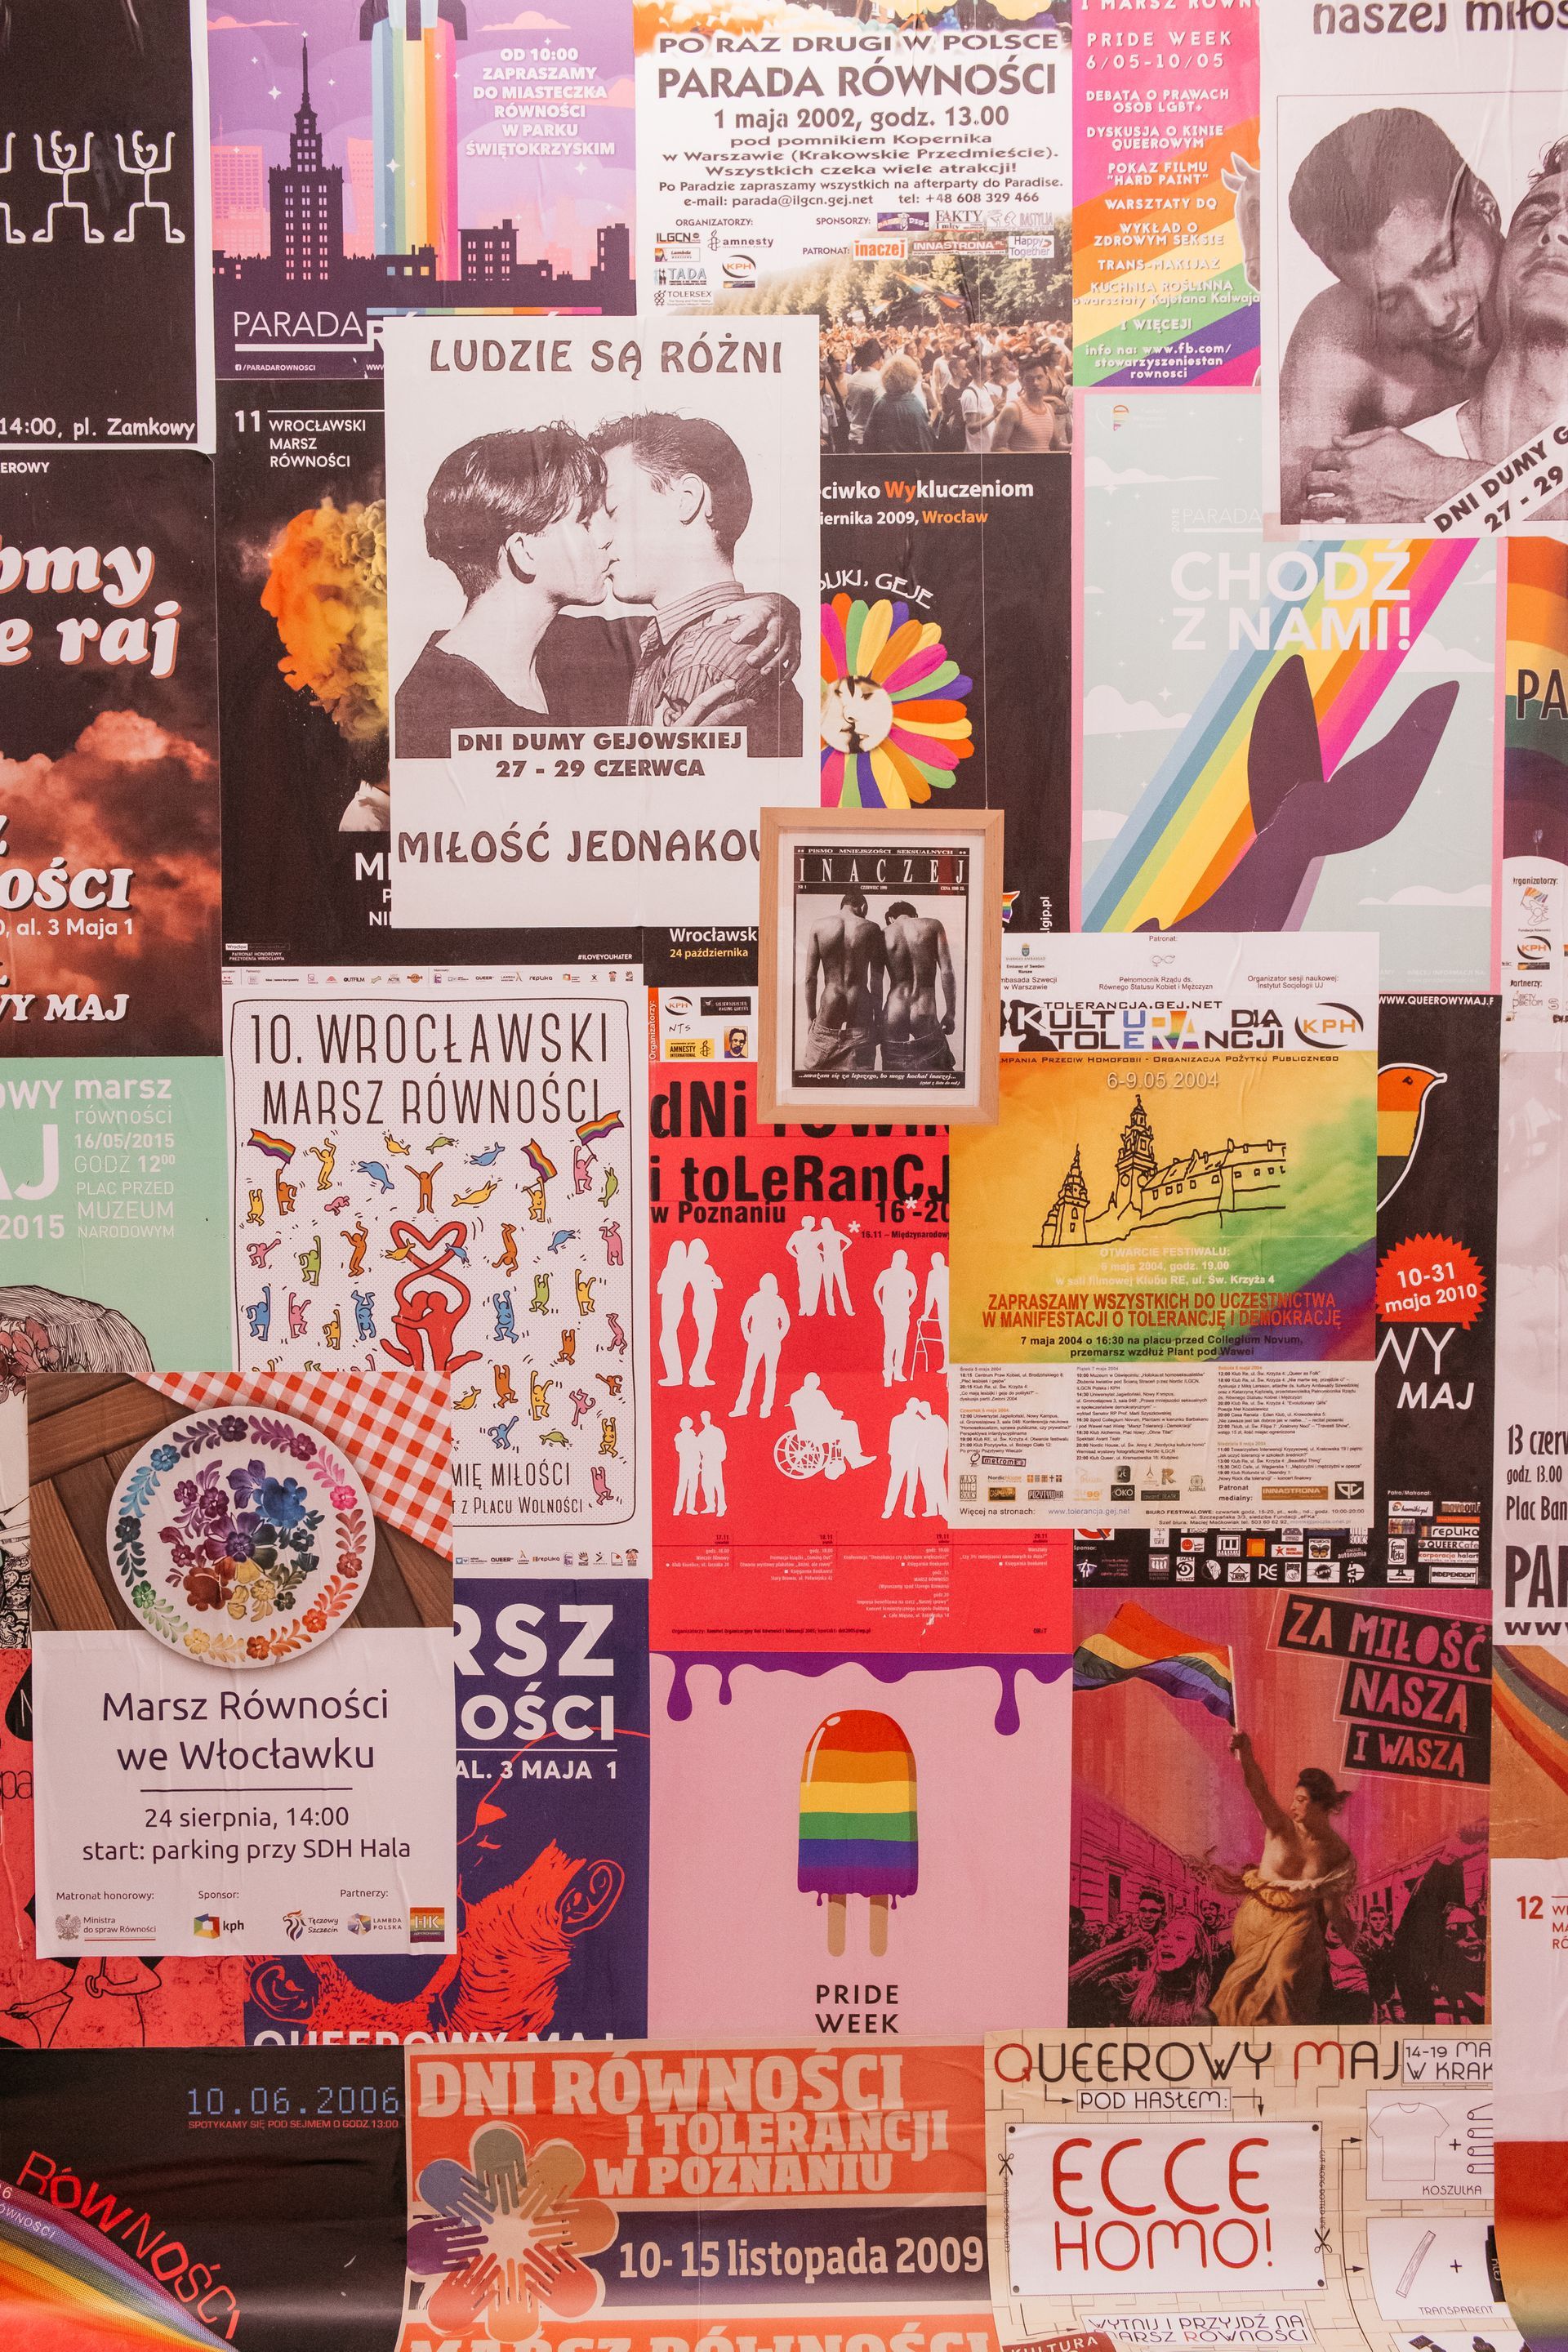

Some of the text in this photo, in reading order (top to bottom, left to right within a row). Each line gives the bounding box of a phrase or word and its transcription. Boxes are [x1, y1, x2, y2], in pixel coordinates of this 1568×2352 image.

[1312, 0, 1446, 35] naszej
[658, 33, 1058, 54] PO RAZ DRUGI W POLSCE
[1086, 31, 1232, 47] PRIDE WEEK
[499, 48, 579, 61] OD 10:00
[1085, 52, 1224, 69] 6/05-10/05
[481, 66, 597, 81] ZAPRASZAMY
[657, 55, 1056, 99] PARADA RÓWNOŚCI
[472, 85, 608, 100] DO MIASTECZKA
[493, 100, 586, 118] RÓWNOŚCI
[714, 105, 1009, 132] 1 maja 2002, godz. 13.00
[501, 123, 580, 136] W PARKU
[466, 139, 616, 158] ŚWIĘTOKRZYSKIM
[675, 218, 754, 227] ORGANIZATORZY:
[815, 216, 871, 225] SPONSORZY:
[802, 247, 850, 256] PATRONAT:
[854, 239, 906, 259] inaczej
[233, 311, 363, 338] PARADA
[430, 332, 783, 381] LUDZIE SĄ RÓŻNI
[0, 416, 196, 443] 14:00, pl. Zamkowy
[234, 410, 366, 433] 11 WROCŁAWSKI
[269, 437, 317, 450] MARSZ
[270, 452, 350, 468] RÓWNOŚCI
[884, 481, 1034, 500] Wykluczeniom
[876, 509, 989, 527] 2009, Wrocław
[1169, 540, 1411, 602] CHODŹ
[57, 601, 180, 677] raj
[1229, 607, 1412, 652] NAMI!
[457, 732, 742, 751] DNI DUMY GEJOWSKIEJ
[495, 761, 524, 778] 27
[555, 760, 586, 778] 29
[594, 760, 706, 778] CZERWCA
[398, 820, 550, 864] MIŁOŚĆ
[839, 847, 893, 855] MNIEJSZOŚCI
[798, 858, 966, 885] INACZEJ
[21, 918, 133, 937] al. 3 Maja 1
[43, 994, 130, 1022] MAJ
[1043, 1000, 1223, 1010] TOLERANCJA.GEJ.NET
[648, 1000, 658, 1060] Organizatorzy:
[1303, 1018, 1356, 1034] KPH
[251, 1013, 608, 1065] 10. WROCŁAWSKI
[74, 1076, 172, 1100] marsz
[1106, 1071, 1219, 1090] 6-9.05.2004
[262, 1072, 599, 1125] MARSZ RÓWNOŚCI
[74, 1105, 172, 1125] równości
[74, 1132, 175, 1149] 16/05/2015
[75, 1180, 175, 1196] PLAC PRZED
[78, 1200, 175, 1220] MUZEUM
[651, 1200, 786, 1223] w Poznaniu
[78, 1225, 175, 1239] NARODOWYM
[1395, 1261, 1456, 1290] 10-31
[988, 1292, 1336, 1311] ZAPRASZAMY WSZYSTKICH DO UCZESTNICTWA
[1384, 1283, 1478, 1314] maja 2010
[982, 1309, 1342, 1330] W MANIFESTACJI O TOLERANCJĘ I DEMOKRACJĘ
[1396, 1382, 1473, 1410] MAJ
[491, 1460, 571, 1486] MIŁOŚCI
[1507, 1465, 1562, 1485] godz. 13.00
[959, 1507, 986, 1517] Więcej
[1000, 1507, 1036, 1516] stronach:
[1048, 1507, 1130, 1517] www.tolerancja.gej.net
[1282, 1601, 1492, 1676] ZA MIŁOŚĆ
[102, 1688, 390, 1722] Marsz Równości
[1348, 1666, 1468, 1734] NASZĄ
[117, 1740, 375, 1771] we Włocławku
[1353, 1731, 1467, 1778] I WASZĄ
[500, 1761, 514, 1780] 3
[521, 1760, 592, 1780] MAJA
[607, 1761, 617, 1780] 1
[145, 1806, 350, 1833] 24 sierpnia, 14:00
[82, 1838, 411, 1865] start: parking przy SDH Hala
[56, 1891, 154, 1902] Matronat honorowy:
[198, 1890, 238, 1901] Sponsor:
[340, 1888, 389, 1900] Partnerzy:
[223, 1919, 245, 1934] kph
[816, 1984, 900, 2005] PRIDE
[815, 2013, 900, 2034] WEEK
[995, 2041, 1401, 2084] QUEEROWY MAJ
[417, 2045, 905, 2116] DNI RÓWNOŚCI
[186, 2085, 399, 2118] 10.06.2006
[1080, 2091, 1125, 2110] POD
[627, 2111, 950, 2163] I TOLERANCJI
[594, 2154, 893, 2196] W POZNANIU
[1052, 2138, 1270, 2217] ECCE
[1054, 2217, 1272, 2272] HOMO!
[727, 2238, 889, 2280] listopada
[896, 2234, 984, 2274] 2009
[1419, 2305, 1494, 2317] TRANSPARENT
